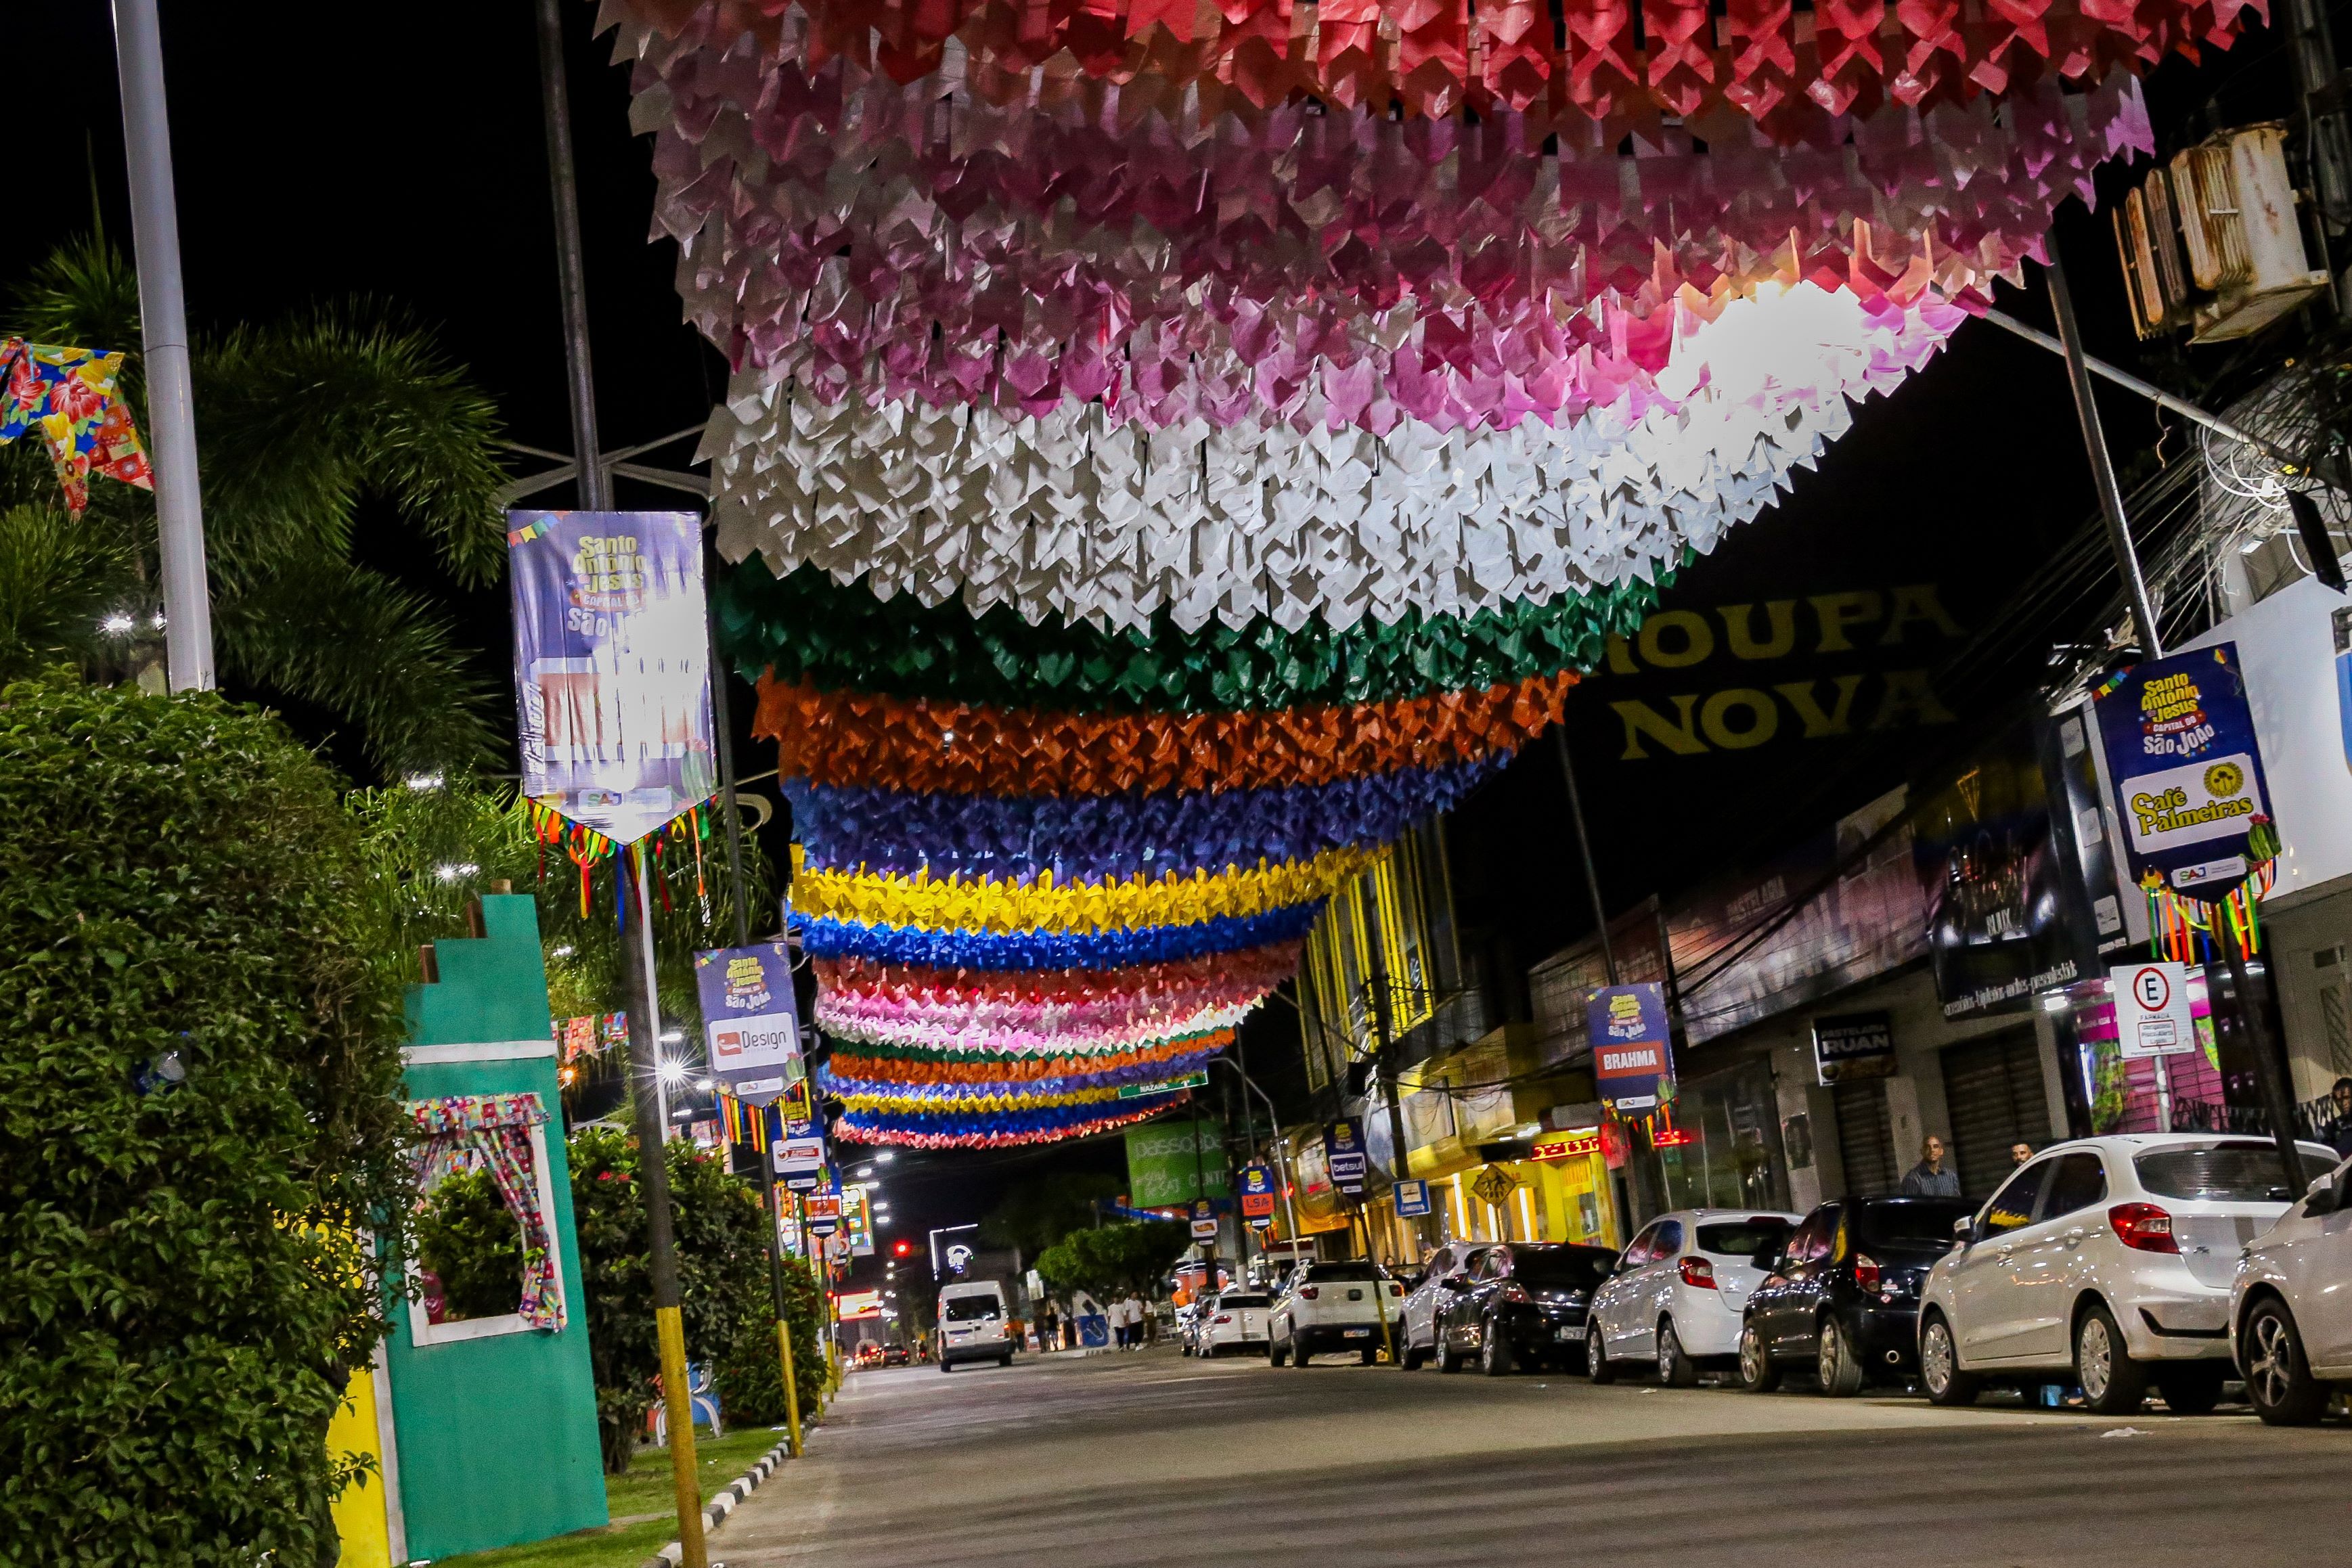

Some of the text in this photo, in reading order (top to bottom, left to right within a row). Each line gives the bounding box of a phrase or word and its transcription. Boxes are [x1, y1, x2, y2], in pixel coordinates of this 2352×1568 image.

[579, 535, 638, 558] Santo
[567, 607, 607, 636] São
[2144, 673, 2189, 697] Santo
[1608, 671, 1959, 761] NOVA
[2152, 700, 2198, 722] Jesus
[2153, 721, 2185, 732] CAPITAL
[2143, 734, 2175, 755] São
[587, 792, 622, 807] SAJ
[2131, 786, 2188, 815] Café
[2138, 797, 2254, 836] Palmeiras
[2179, 866, 2206, 882] SAJ
[2145, 977, 2158, 1002] E
[741, 1030, 786, 1050] Design
[1821, 1033, 1890, 1055] RUAN
[1603, 1050, 1657, 1071] BRAHMA
[1333, 1161, 1362, 1172] betsul
